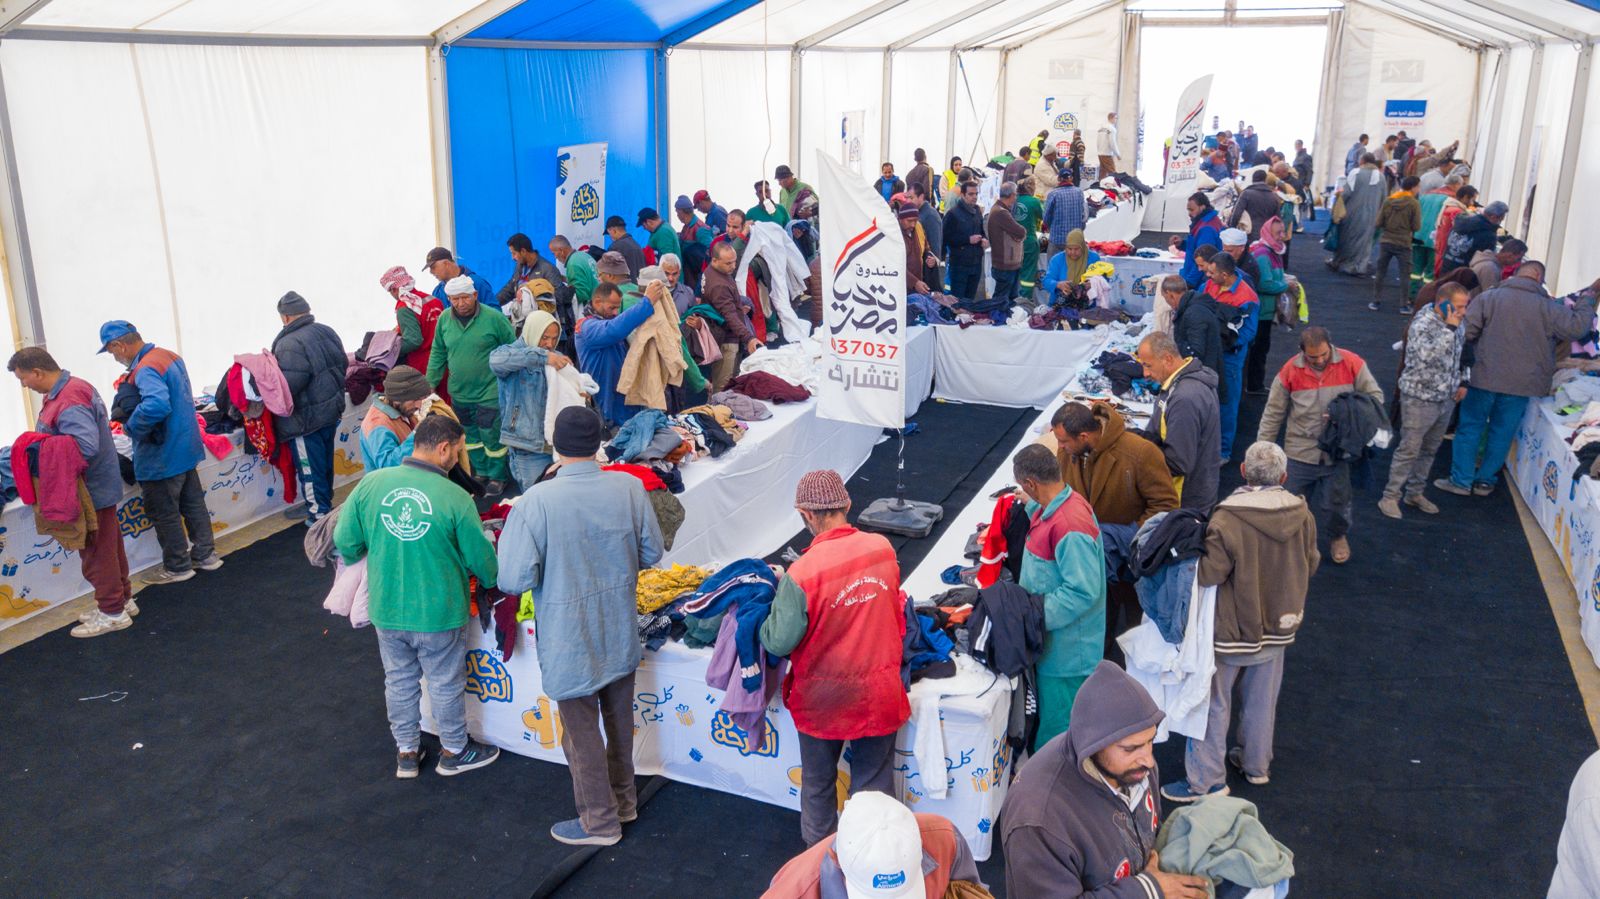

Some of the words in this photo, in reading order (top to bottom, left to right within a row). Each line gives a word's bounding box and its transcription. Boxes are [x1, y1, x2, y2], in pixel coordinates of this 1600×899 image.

[573, 184, 598, 207] دكان
[571, 199, 598, 224] الفرحة
[855, 263, 899, 279] صندوق
[830, 305, 898, 336] مصر
[828, 363, 899, 392] نتشارك
[465, 676, 512, 701] الفرح
[637, 685, 675, 710] كل
[641, 708, 664, 727] يوم
